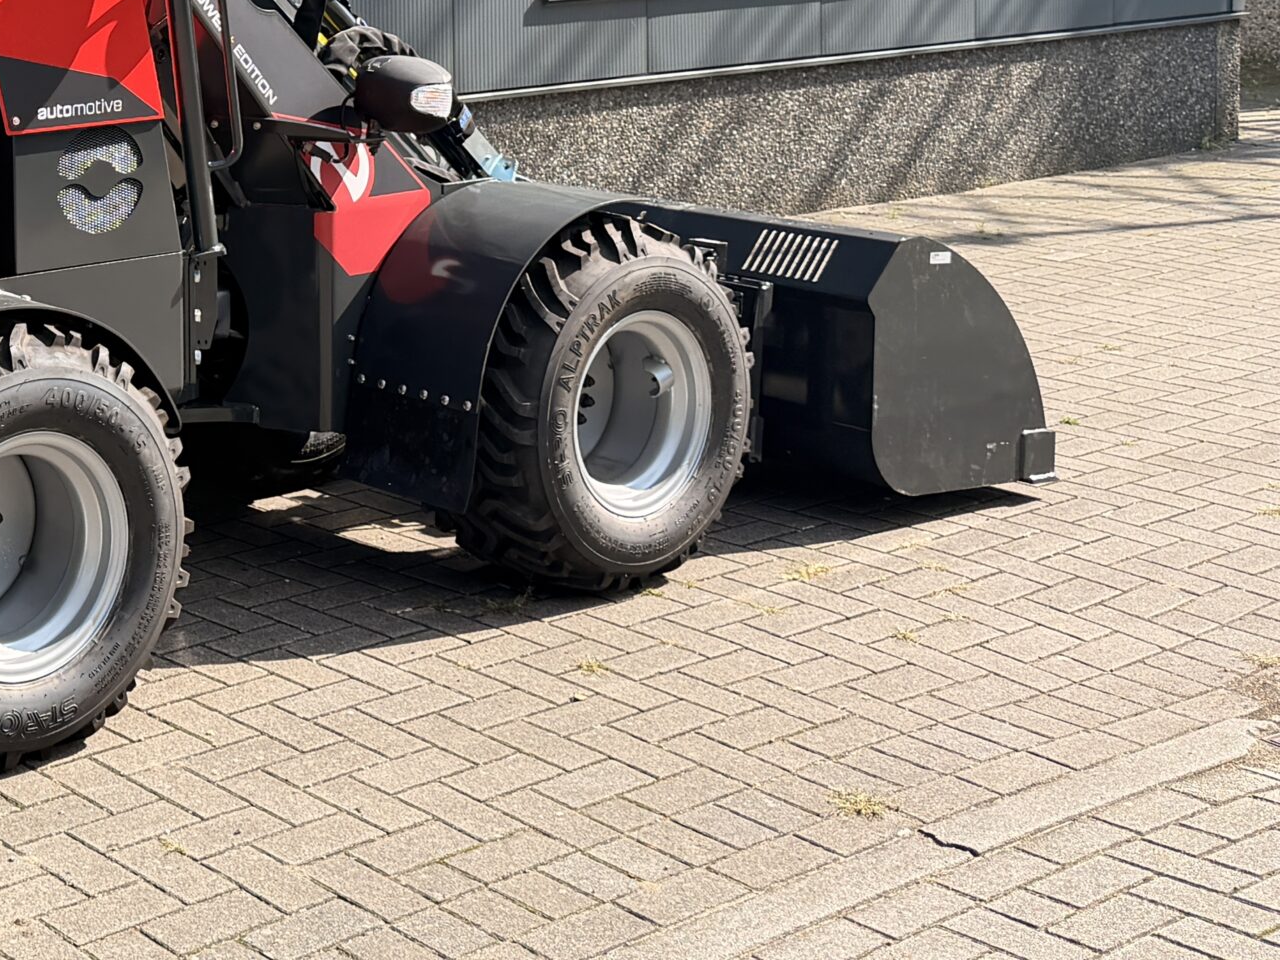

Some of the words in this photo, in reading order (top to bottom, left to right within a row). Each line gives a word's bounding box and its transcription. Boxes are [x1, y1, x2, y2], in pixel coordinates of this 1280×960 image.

[233, 44, 278, 106] EDITION
[37, 98, 123, 120] automotive
[560, 289, 621, 393] ALPTRAK
